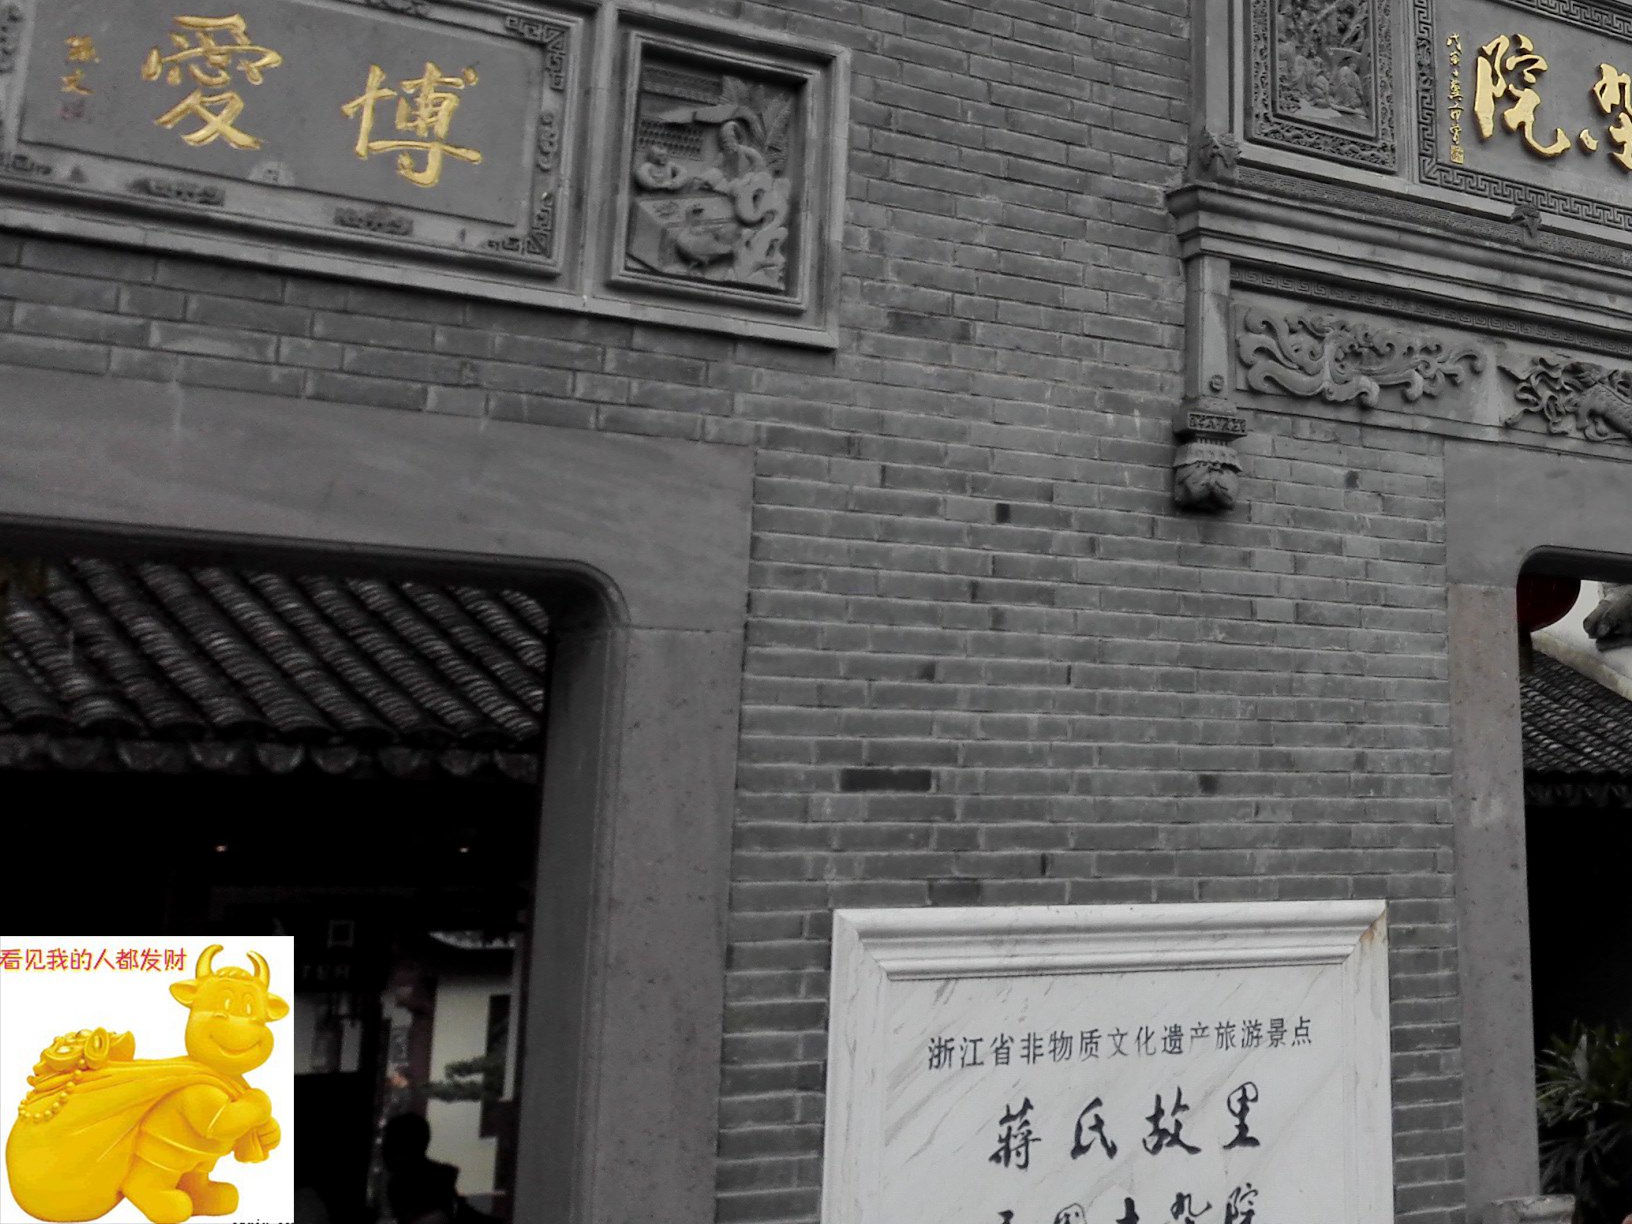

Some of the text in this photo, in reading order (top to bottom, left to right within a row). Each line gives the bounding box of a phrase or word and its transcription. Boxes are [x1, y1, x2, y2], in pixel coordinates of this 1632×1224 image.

[927, 1016, 1312, 1070] 浙江省非物质文化遗产旅游景点
